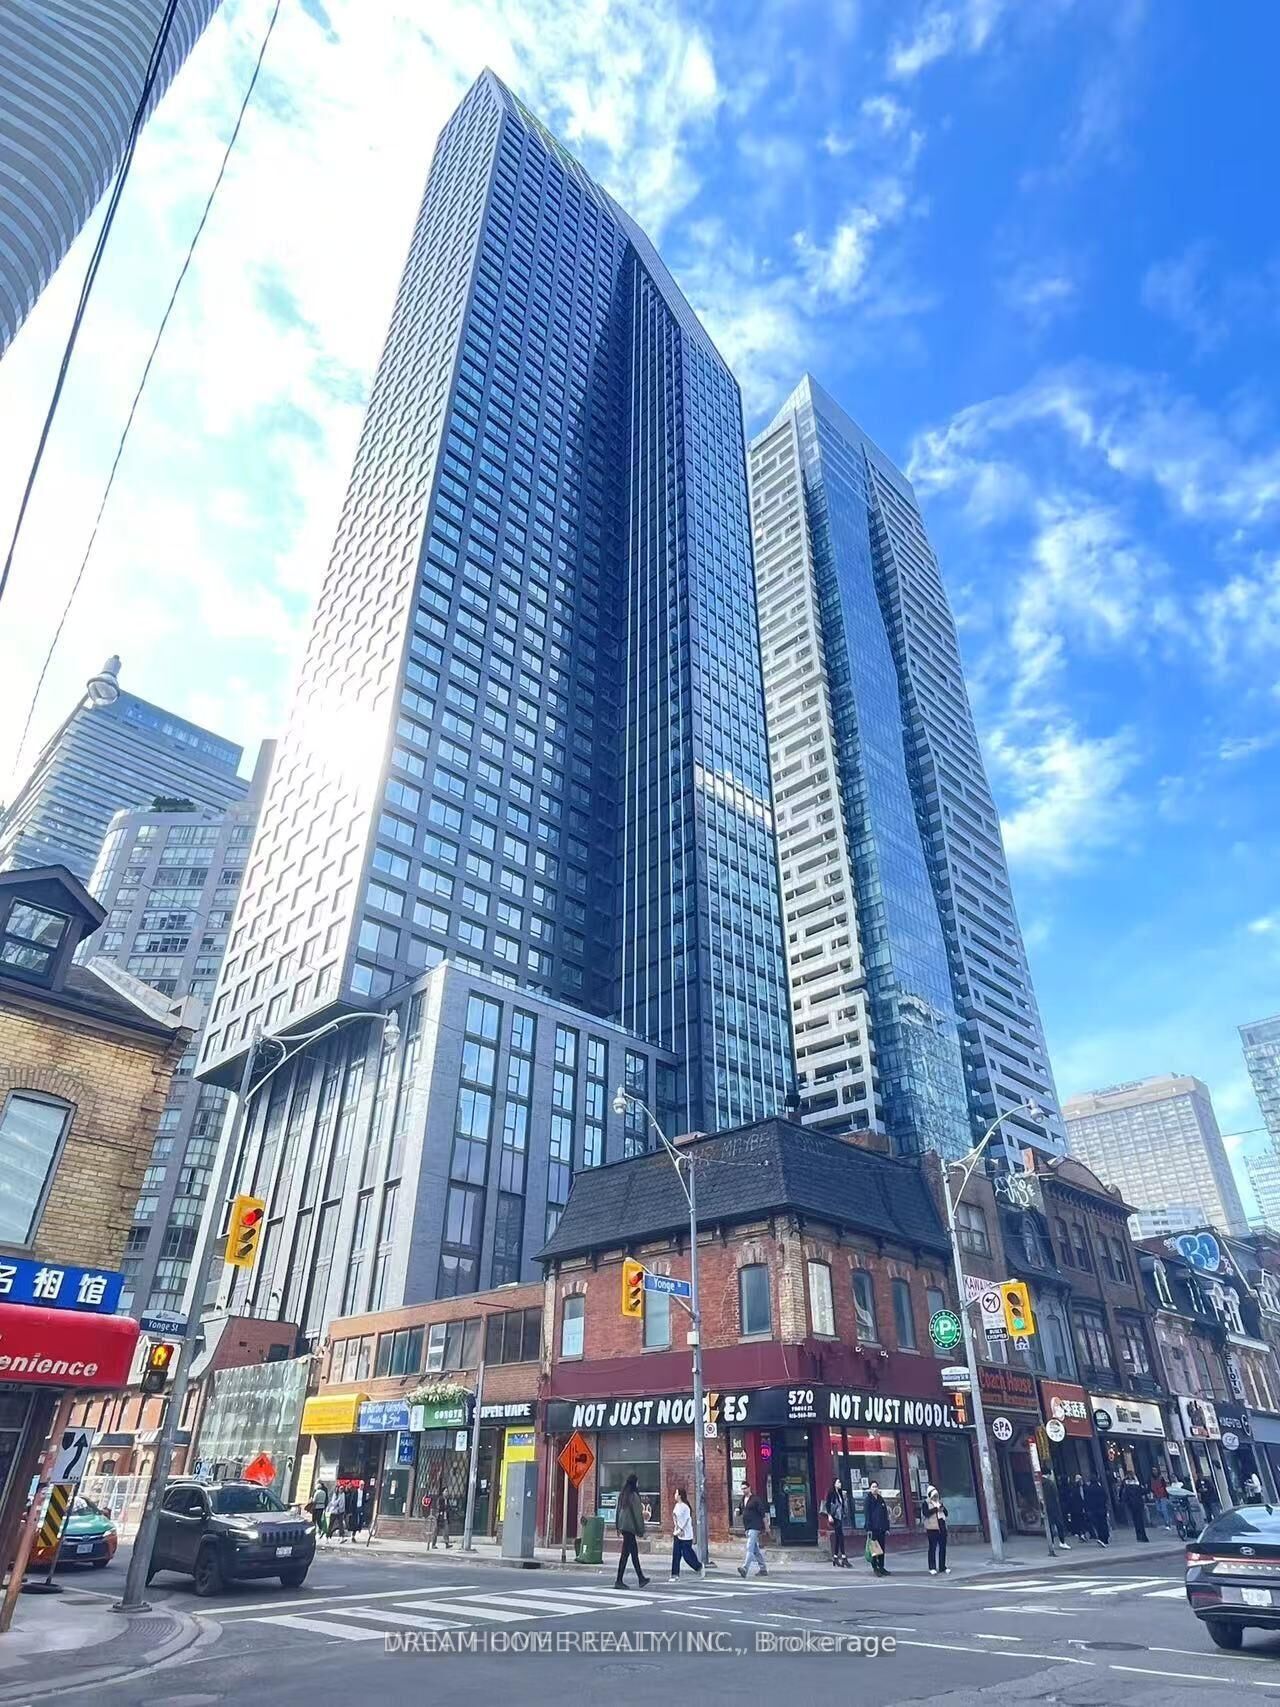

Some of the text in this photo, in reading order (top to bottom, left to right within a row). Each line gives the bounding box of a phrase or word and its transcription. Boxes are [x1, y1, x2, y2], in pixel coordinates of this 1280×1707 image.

[653, 1277, 675, 1293] Yonge
[148, 1319, 179, 1332] Yonge St
[787, 1389, 814, 1406] 570
[504, 1403, 532, 1417] VAPE
[572, 1403, 607, 1428] NOT
[609, 1400, 654, 1426] JUST
[829, 1392, 862, 1421] NOT
[864, 1396, 901, 1424] JUST
[993, 1419, 1011, 1432] SPA
[732, 1438, 742, 1448] Set
[729, 1448, 747, 1460] Lunch
